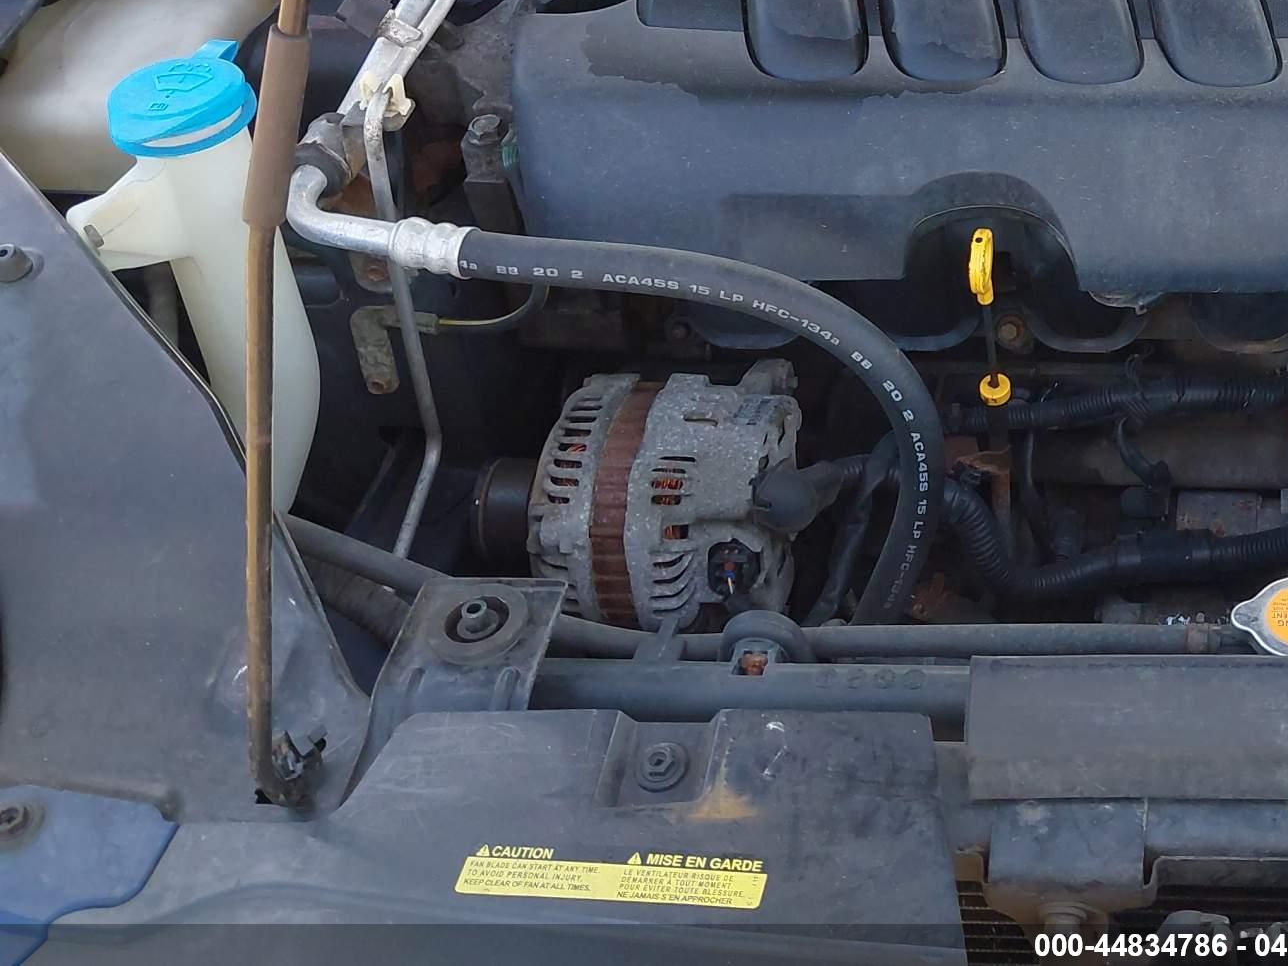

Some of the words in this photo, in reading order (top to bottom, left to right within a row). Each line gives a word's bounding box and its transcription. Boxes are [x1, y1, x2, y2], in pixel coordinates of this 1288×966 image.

[532, 267, 559, 277] 20
[571, 270, 584, 279] 2
[603, 273, 679, 290] ACA45S
[689, 284, 710, 296] 15
[720, 290, 744, 303] LP
[752, 299, 840, 346] HFC-134a
[850, 351, 873, 370] BB
[882, 380, 903, 402] 20
[902, 409, 914, 422] 2
[911, 432, 929, 492] ACA45S
[917, 499, 927, 515] 15
[913, 522, 924, 539] LP
[492, 845, 554, 859] CAUTION
[486, 861, 510, 869] BLADE
[646, 853, 683, 867] MISE
[685, 856, 707, 868] EN
[710, 858, 763, 872] GARDE
[480, 869, 504, 877] AVOID
[506, 871, 550, 880] PERSONAL
[636, 870, 689, 878] VENTILATEUR
[691, 872, 720, 881] RISQUE
[674, 886, 699, 894] TOUTE
